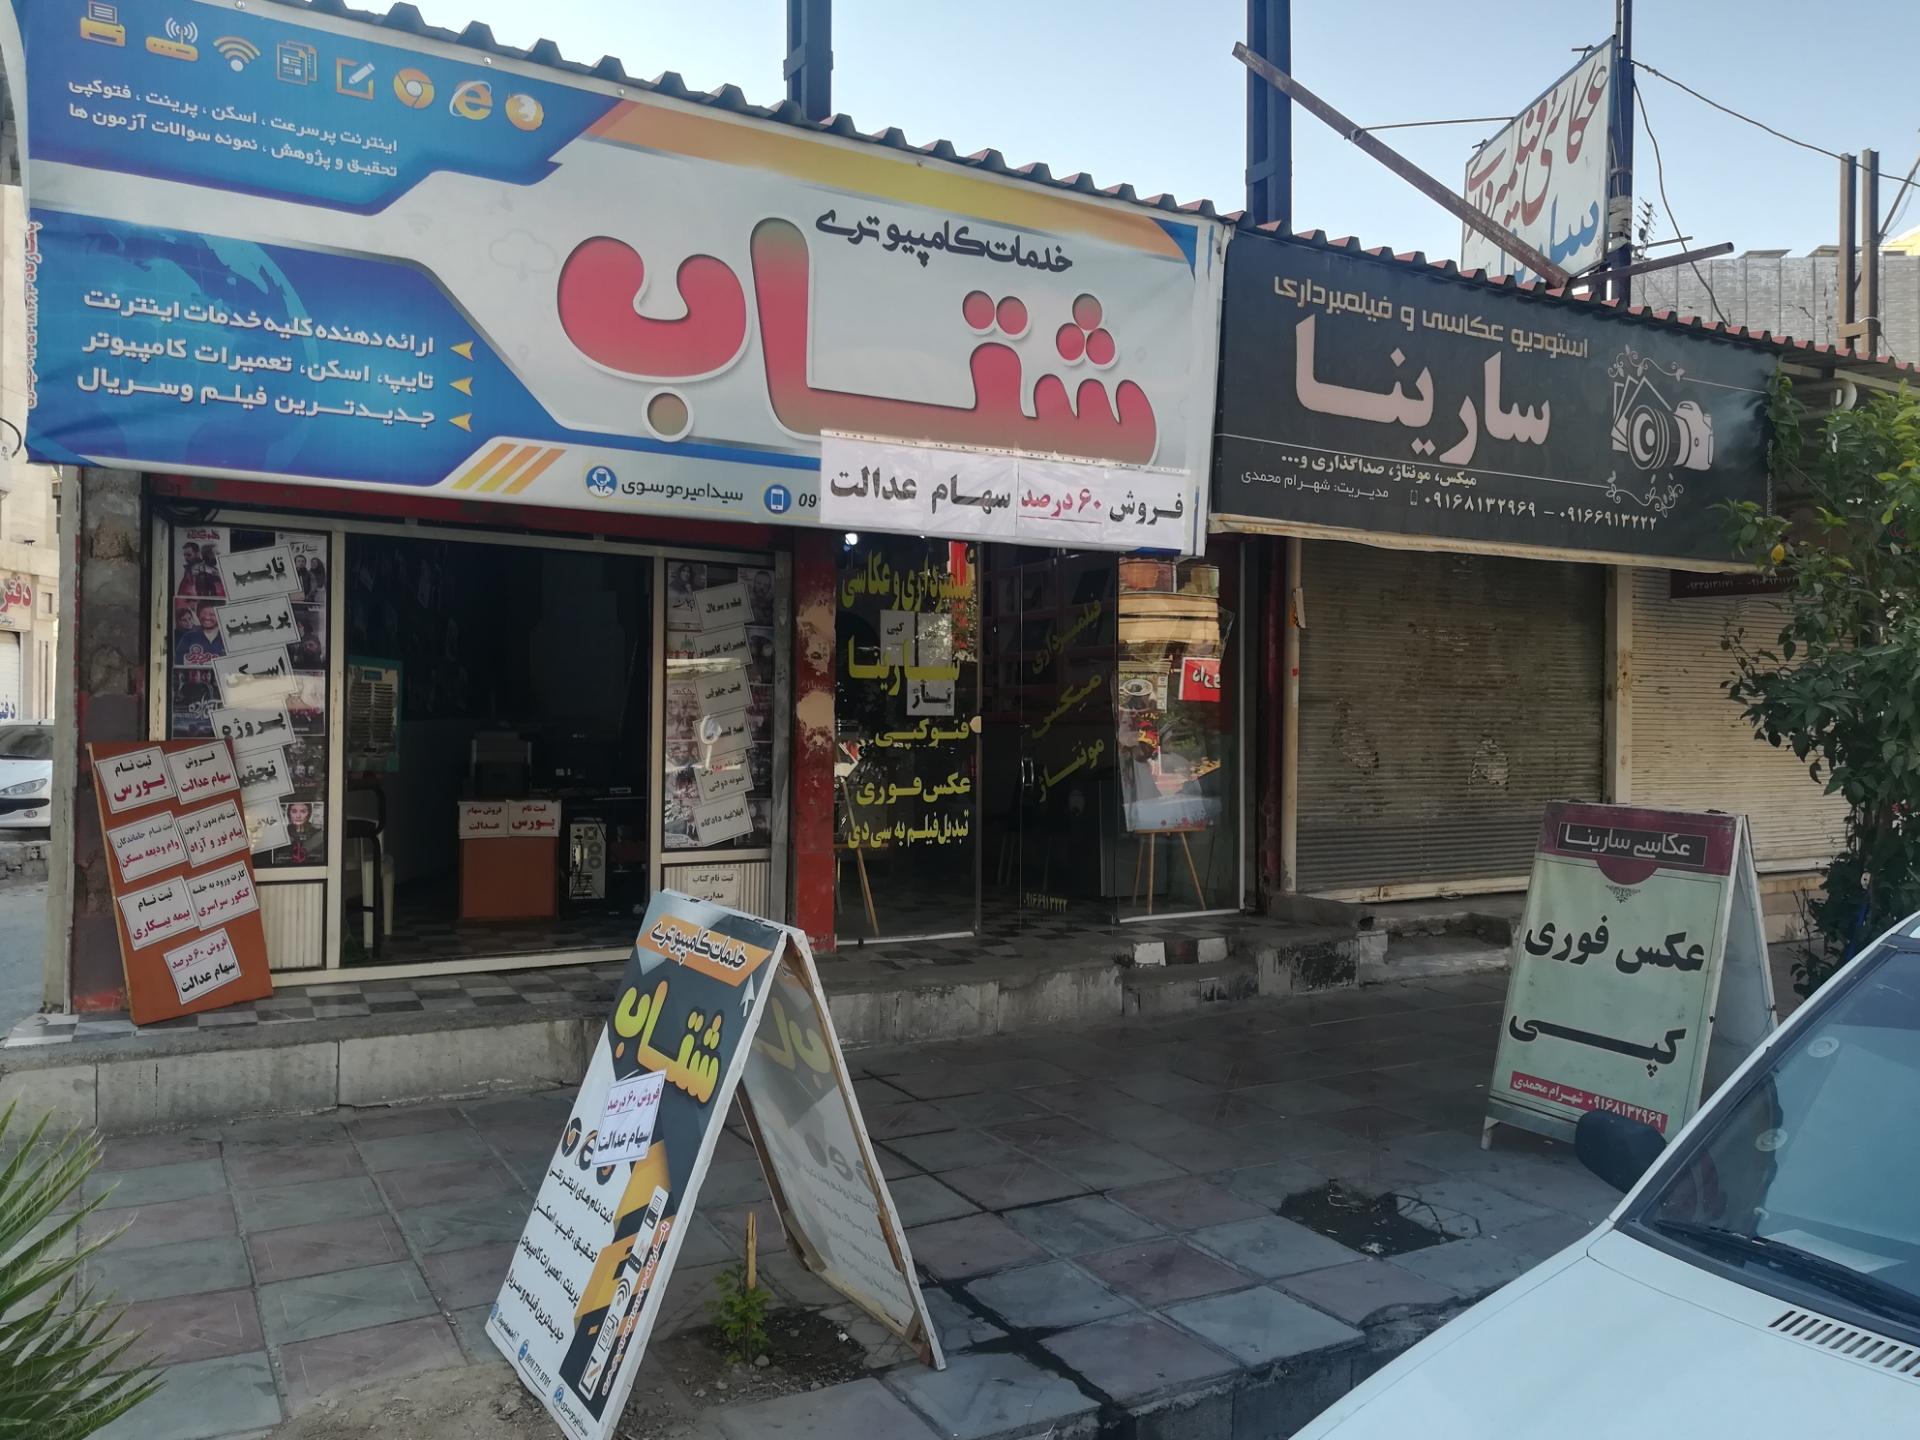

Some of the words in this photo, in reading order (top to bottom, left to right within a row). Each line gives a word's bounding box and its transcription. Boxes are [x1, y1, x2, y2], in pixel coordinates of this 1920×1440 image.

[68, 78, 132, 101] فتوکپی
[69, 102, 88, 120] ها
[145, 91, 198, 117] پرینت
[212, 106, 258, 125] اسکن
[92, 110, 147, 133] آزمون
[151, 119, 211, 144] سوالات
[271, 115, 336, 146] پرسرعت
[214, 133, 258, 152] نمونه
[340, 131, 397, 152] اینترنت
[270, 143, 331, 172] پژوهش
[335, 155, 343, 170] و
[347, 154, 397, 178] تحقیق
[986, 233, 1073, 274] خدمات
[84, 290, 180, 321] اینترنت
[1274, 273, 1393, 319] فیلمبرداری
[183, 302, 262, 330] خدمات
[263, 316, 312, 338] کلیه
[1399, 303, 1415, 332] و
[1422, 309, 1504, 344] عکاسی
[82, 330, 187, 362] کامپیوتر
[315, 325, 384, 349] دهنده
[385, 333, 434, 358] ارائه
[557, 216, 1160, 468] شتاب
[1511, 328, 1589, 360] استودیو
[194, 346, 292, 375] تعمیرات
[200, 384, 267, 407] فیلم
[1295, 313, 1551, 466] سارینا
[274, 389, 435, 428] جدیدترین
[1239, 468, 1282, 488] محمدی
[1311, 455, 1385, 476] صداگذاری
[830, 465, 918, 501] عدالت
[931, 474, 1011, 515] سهام
[1283, 472, 1331, 495] شهرام
[1109, 492, 1184, 526] فروش
[1424, 490, 1537, 519] ۰۹۱۶۸۱۳۲۹۶۹
[842, 550, 891, 608] عکاسی
[848, 635, 961, 696] سارینا
[222, 711, 287, 740] پروژه
[874, 716, 970, 749] فتوکپی
[114, 761, 135, 778] نام
[137, 754, 152, 769] ثبت
[184, 752, 216, 769] فروش
[113, 773, 167, 803] بورس
[180, 779, 210, 794] عدالت
[211, 771, 231, 788] سهام
[856, 776, 922, 805] فوری
[922, 772, 971, 802] عکس
[894, 820, 905, 847] به
[907, 811, 938, 847] فیلم
[937, 809, 970, 845] تبدیل
[1563, 823, 1631, 853] سارینا
[1632, 832, 1692, 859] عکاسی
[137, 896, 156, 912] نام
[157, 887, 173, 902] ثبت
[230, 888, 251, 905] کنکور
[133, 917, 172, 941] بیکاری
[1524, 915, 1610, 965] فوری
[708, 935, 747, 969] خدمات
[1615, 931, 1705, 975] عکس
[181, 972, 212, 993] عدالت
[214, 960, 236, 981] سهام
[613, 980, 722, 1105] شتاب
[1508, 1014, 1687, 1078] کپی
[1512, 1078, 1548, 1095] محمدی
[597, 1129, 626, 1152] عدالت
[626, 1123, 651, 1152] سهام
[599, 1206, 614, 1226] ثبت
